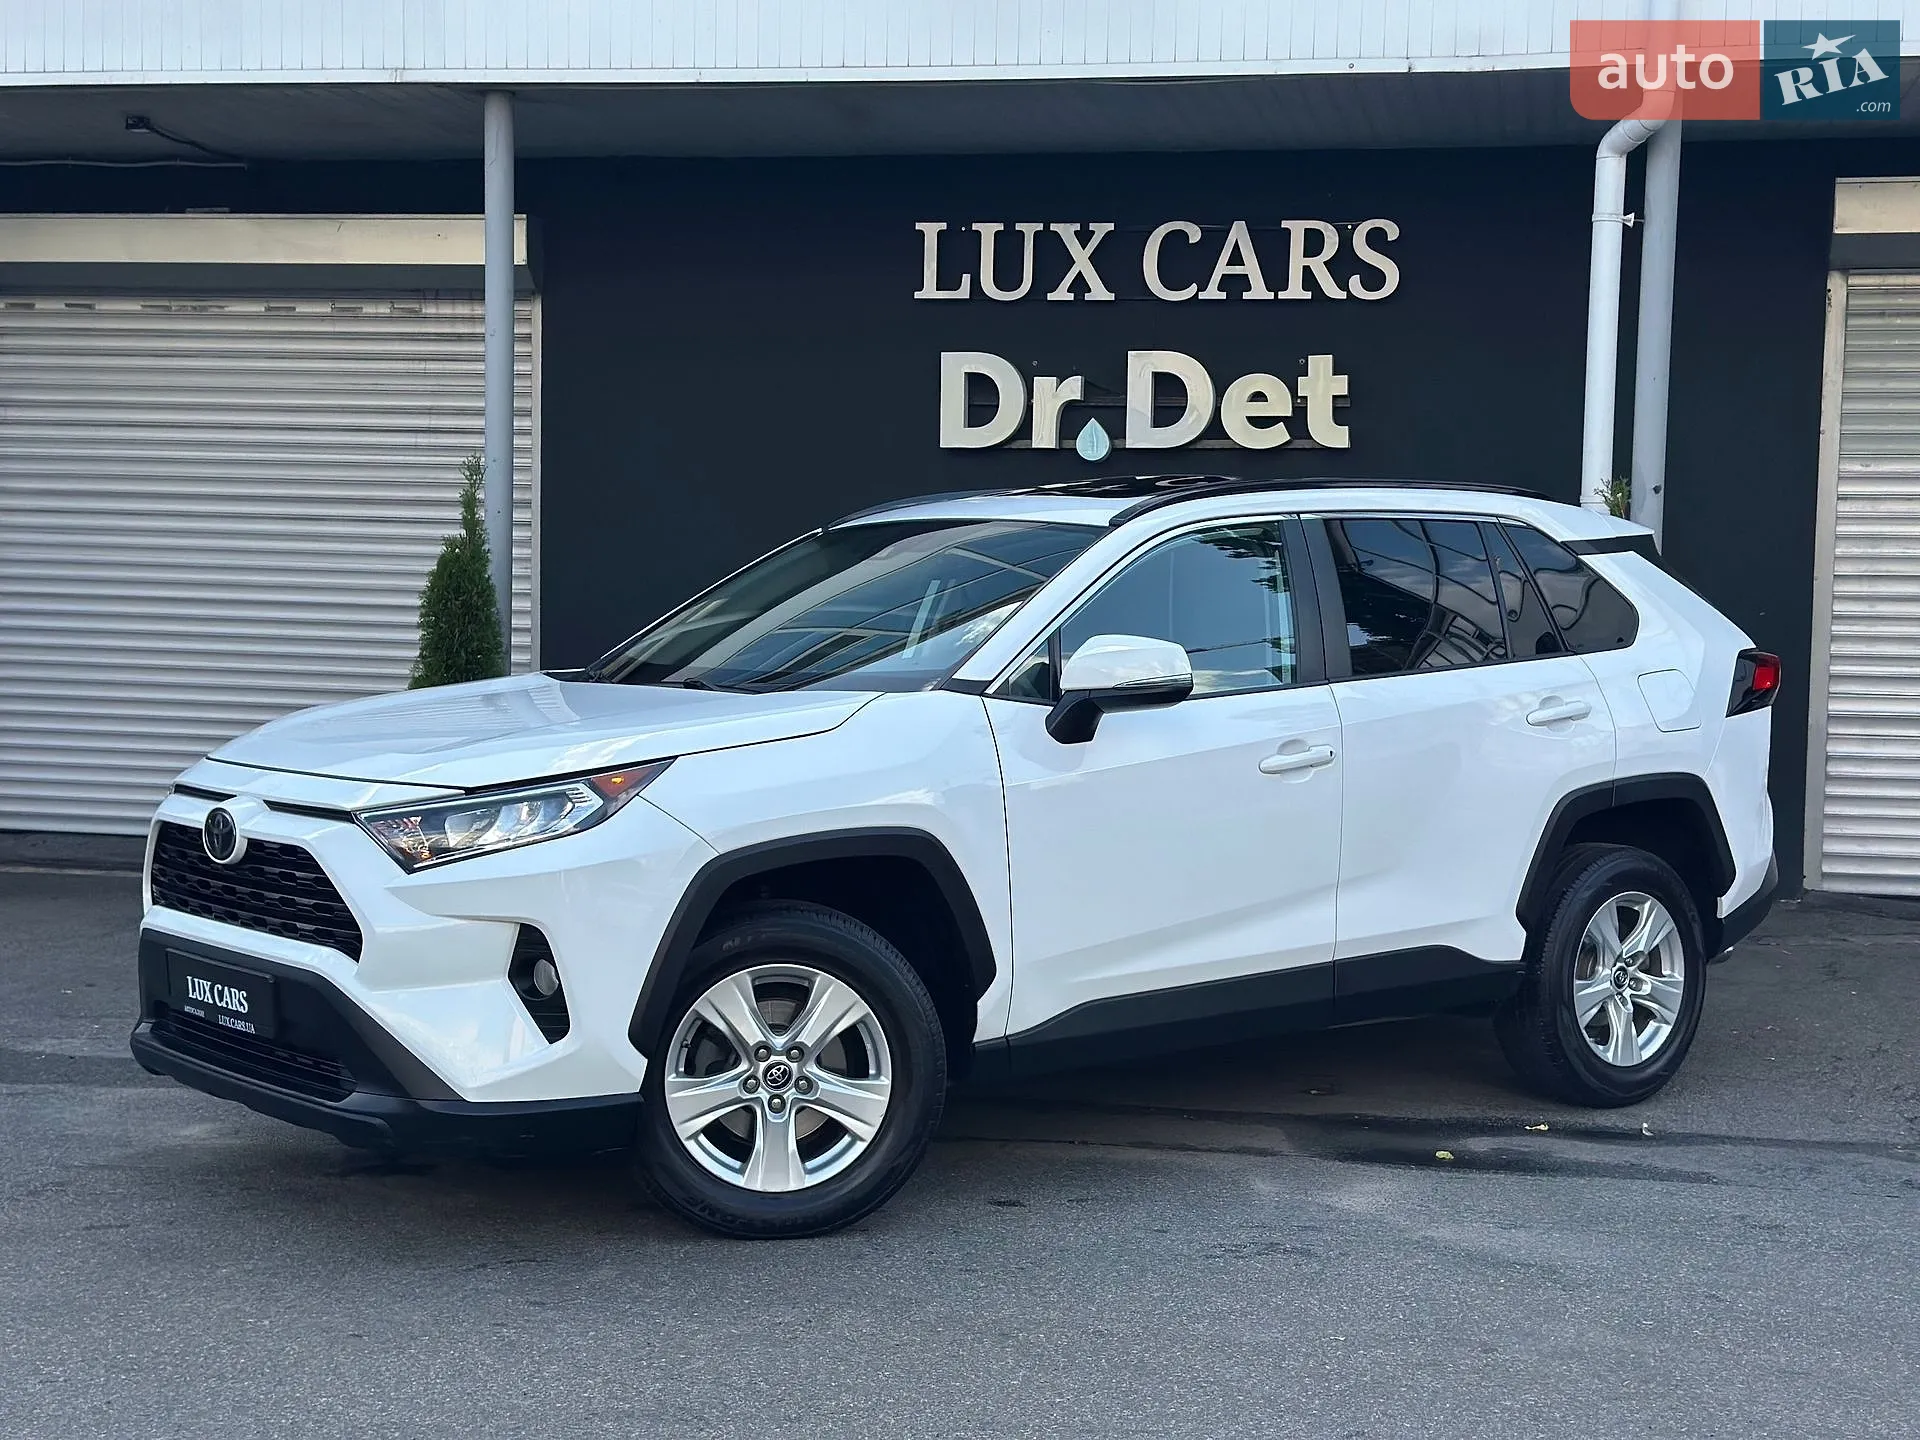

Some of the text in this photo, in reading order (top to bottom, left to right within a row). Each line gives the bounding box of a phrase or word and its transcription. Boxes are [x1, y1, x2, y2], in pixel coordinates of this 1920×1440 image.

[914, 219, 1400, 301] LUX CARS
[186, 976, 213, 1004] LUX
[213, 984, 249, 1014] CARS
